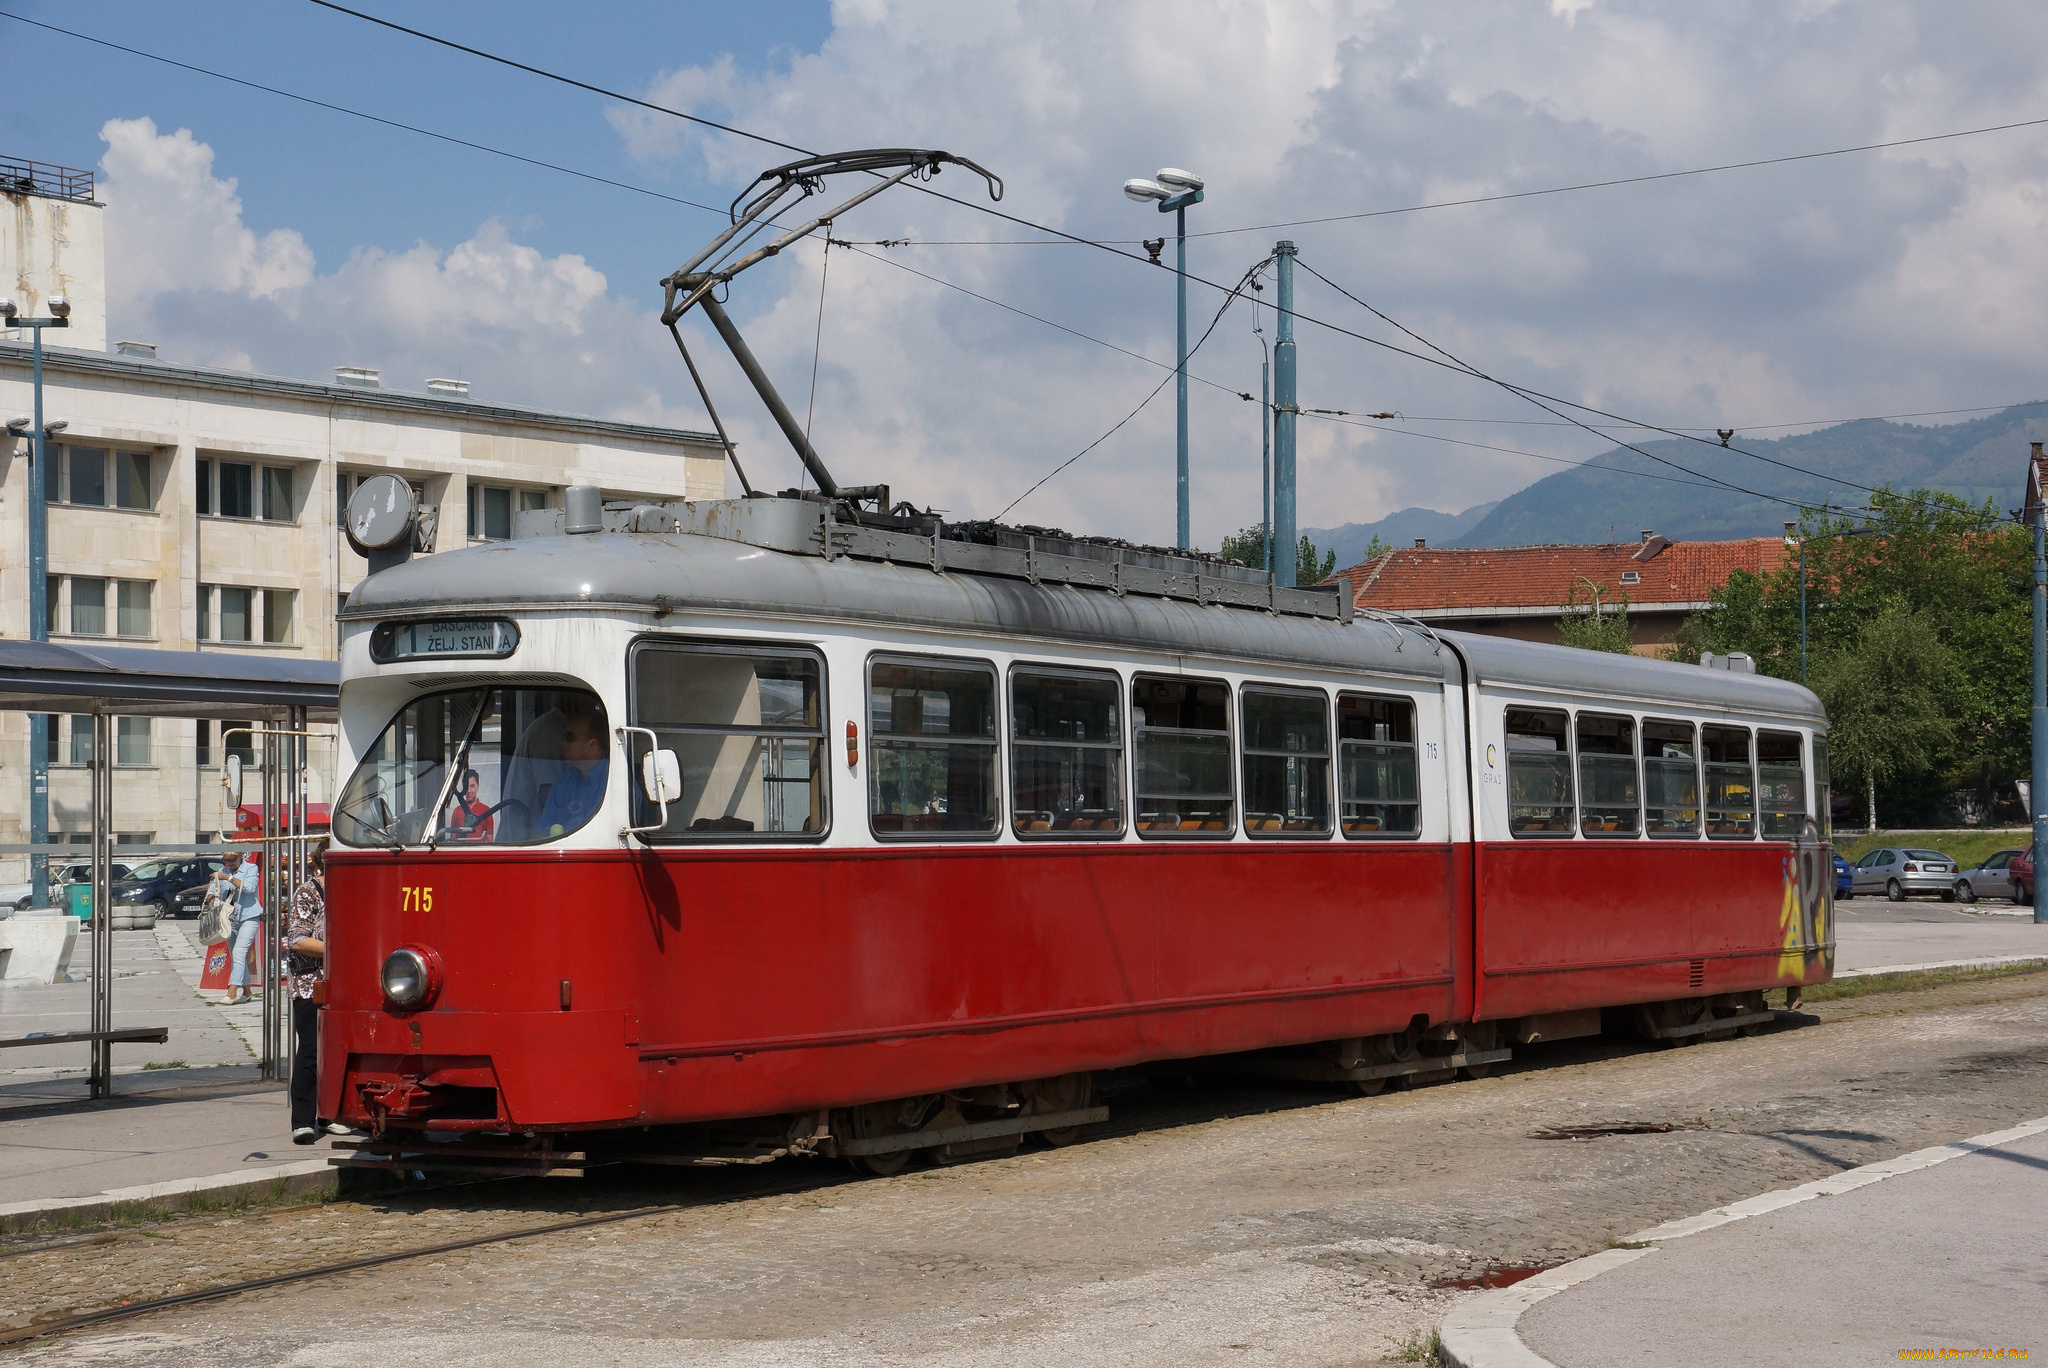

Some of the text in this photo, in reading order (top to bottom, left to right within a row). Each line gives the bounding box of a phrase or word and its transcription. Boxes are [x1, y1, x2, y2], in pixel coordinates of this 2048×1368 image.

[428, 634, 458, 652] ŽELJ.
[1426, 743, 1437, 759] 715
[1484, 773, 1501, 784] GRAS
[402, 887, 433, 912] 715
